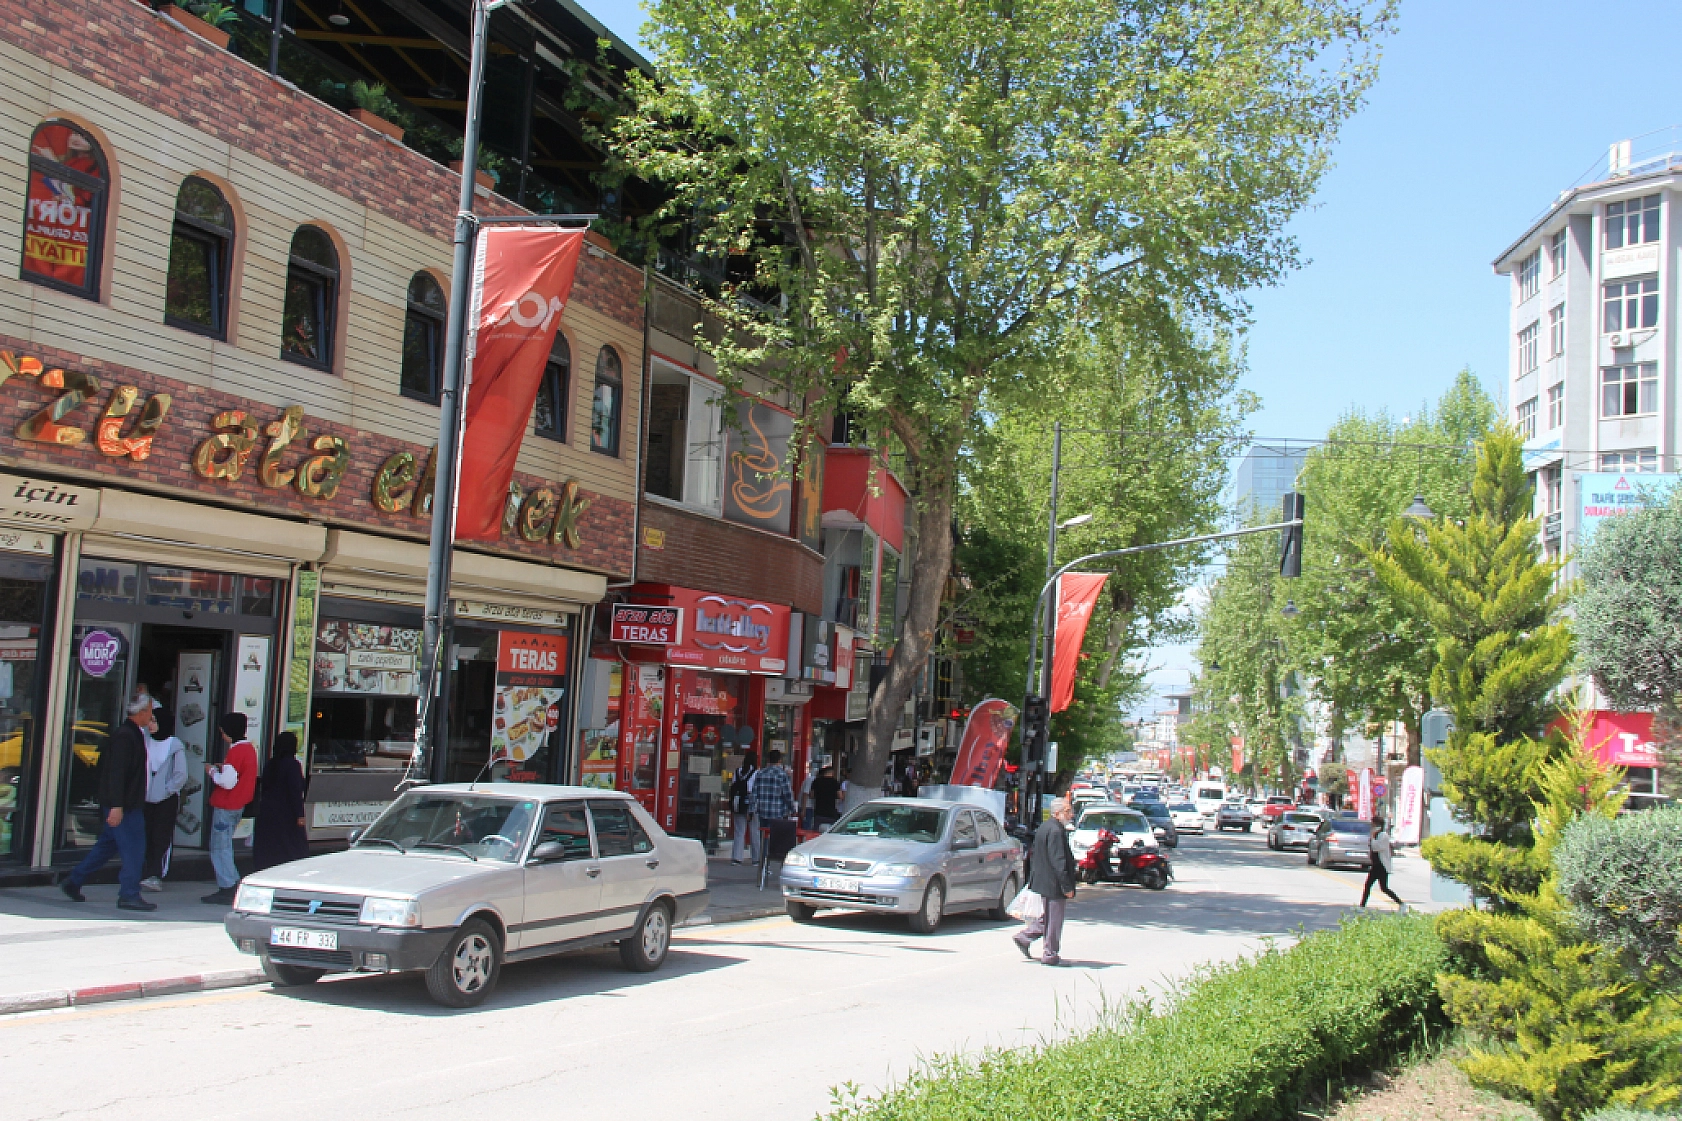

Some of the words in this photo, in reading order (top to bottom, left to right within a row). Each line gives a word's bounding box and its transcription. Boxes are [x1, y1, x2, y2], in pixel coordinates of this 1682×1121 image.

[193, 405, 350, 500] ata
[372, 444, 591, 550] eek
[13, 481, 79, 505] için
[615, 608, 648, 623] arzu
[649, 609, 676, 625] ata
[621, 625, 668, 642] TERAS
[509, 648, 558, 671] TERAS
[279, 930, 291, 943] 44
